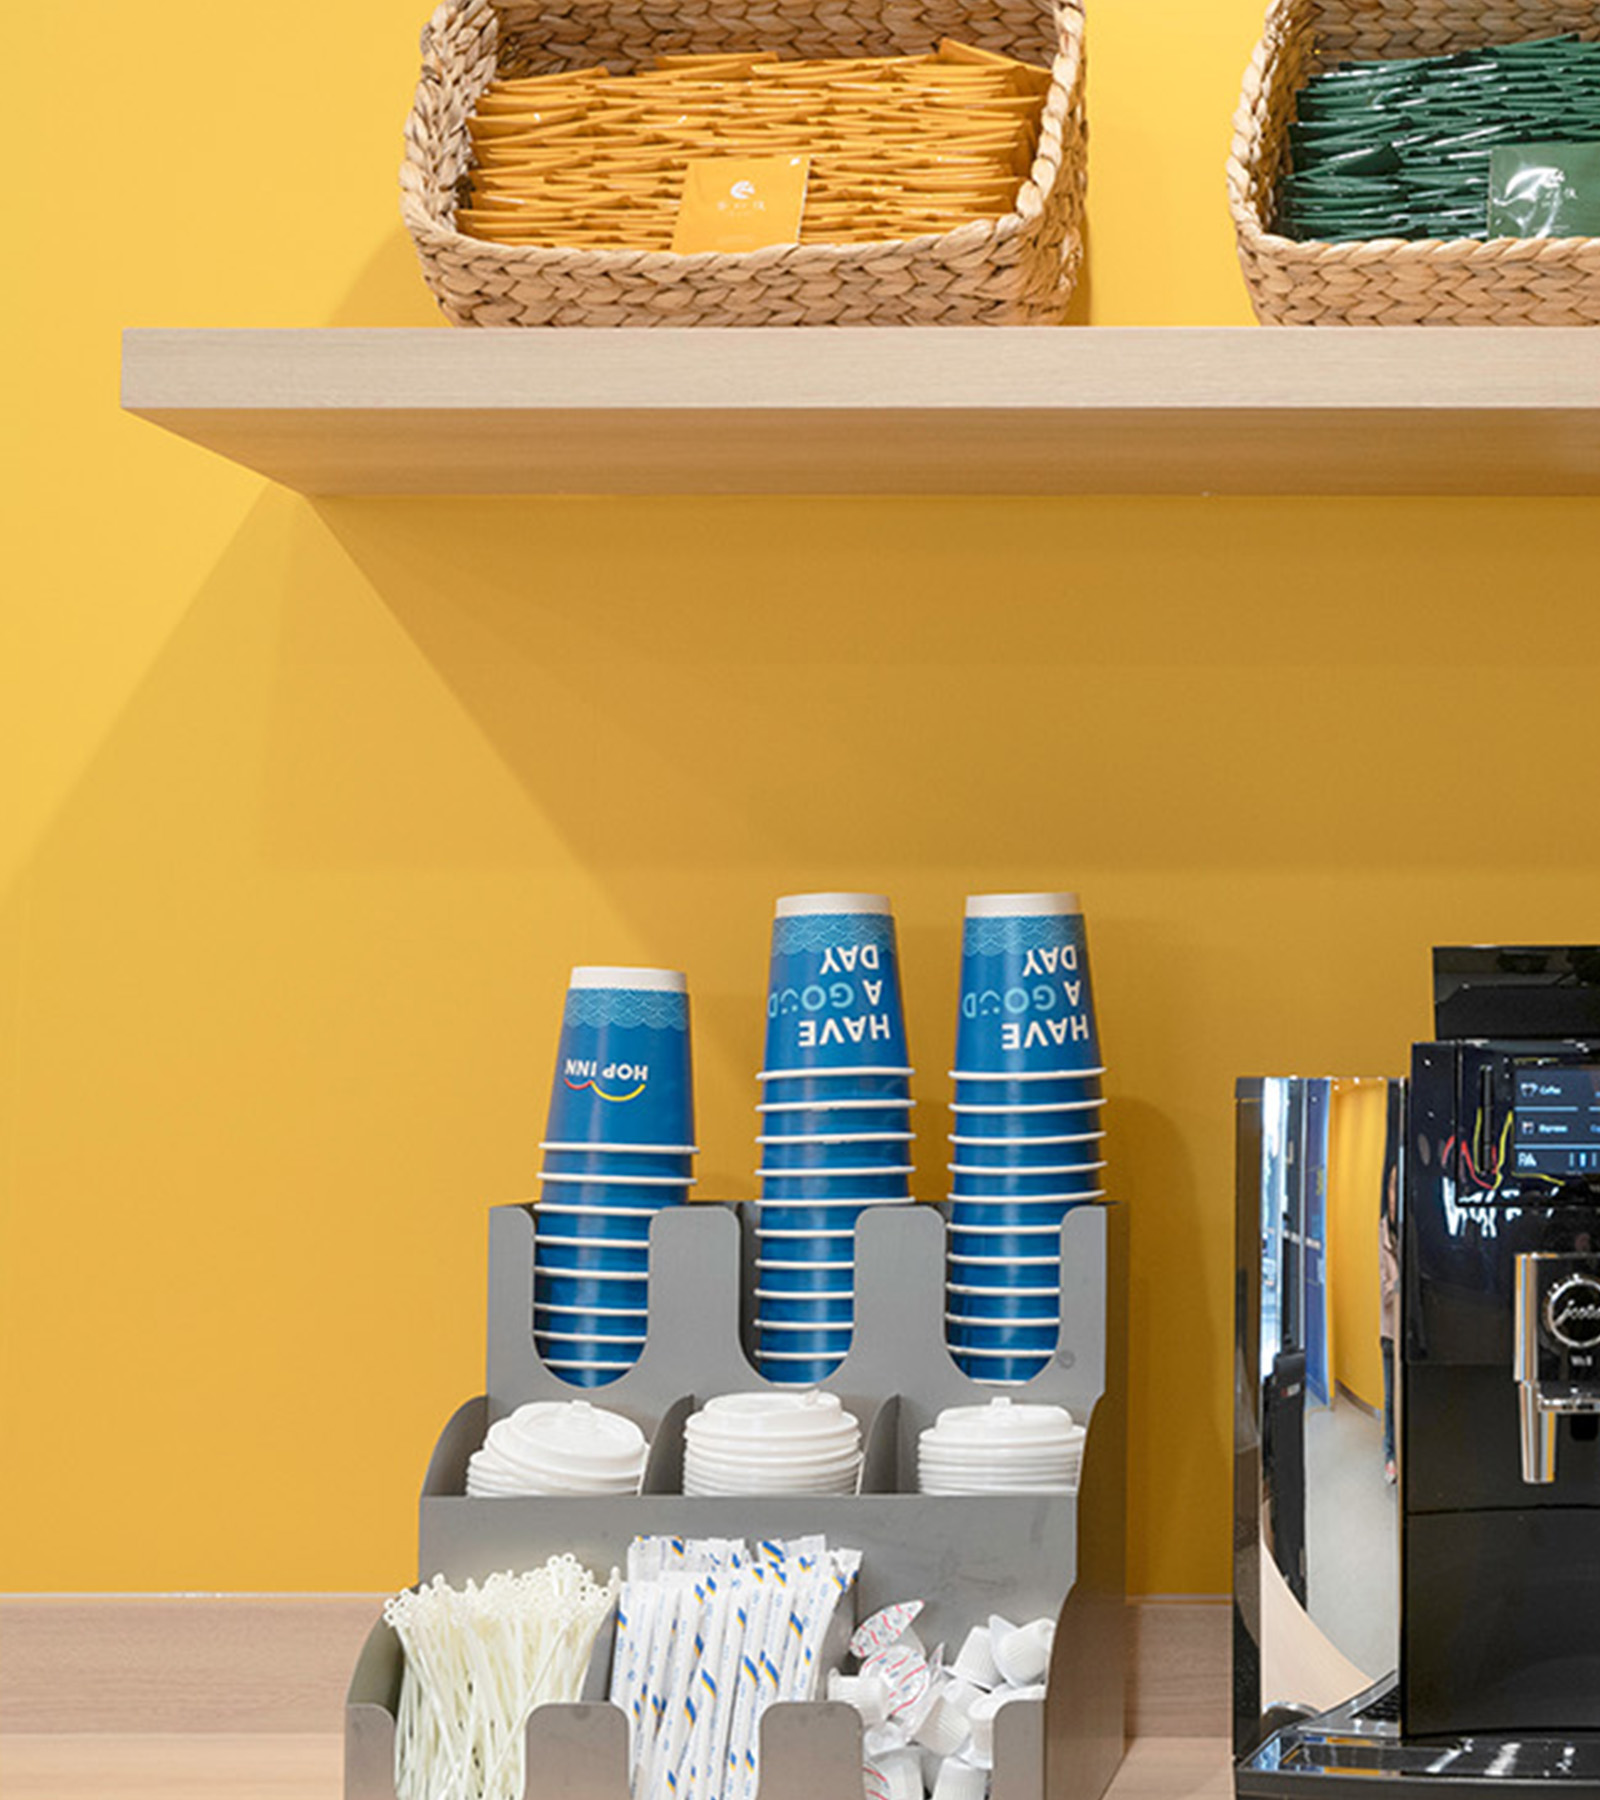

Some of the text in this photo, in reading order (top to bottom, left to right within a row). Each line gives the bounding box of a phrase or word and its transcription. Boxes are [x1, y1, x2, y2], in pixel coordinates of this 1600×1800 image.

[820, 944, 881, 976] DAY
[1022, 944, 1079, 977] DAY
[862, 979, 883, 1006] A
[1063, 979, 1082, 1007] A
[798, 1014, 891, 1047] HAVE
[1001, 1014, 1090, 1050] HAVE
[564, 1058, 649, 1081] HOP INN
